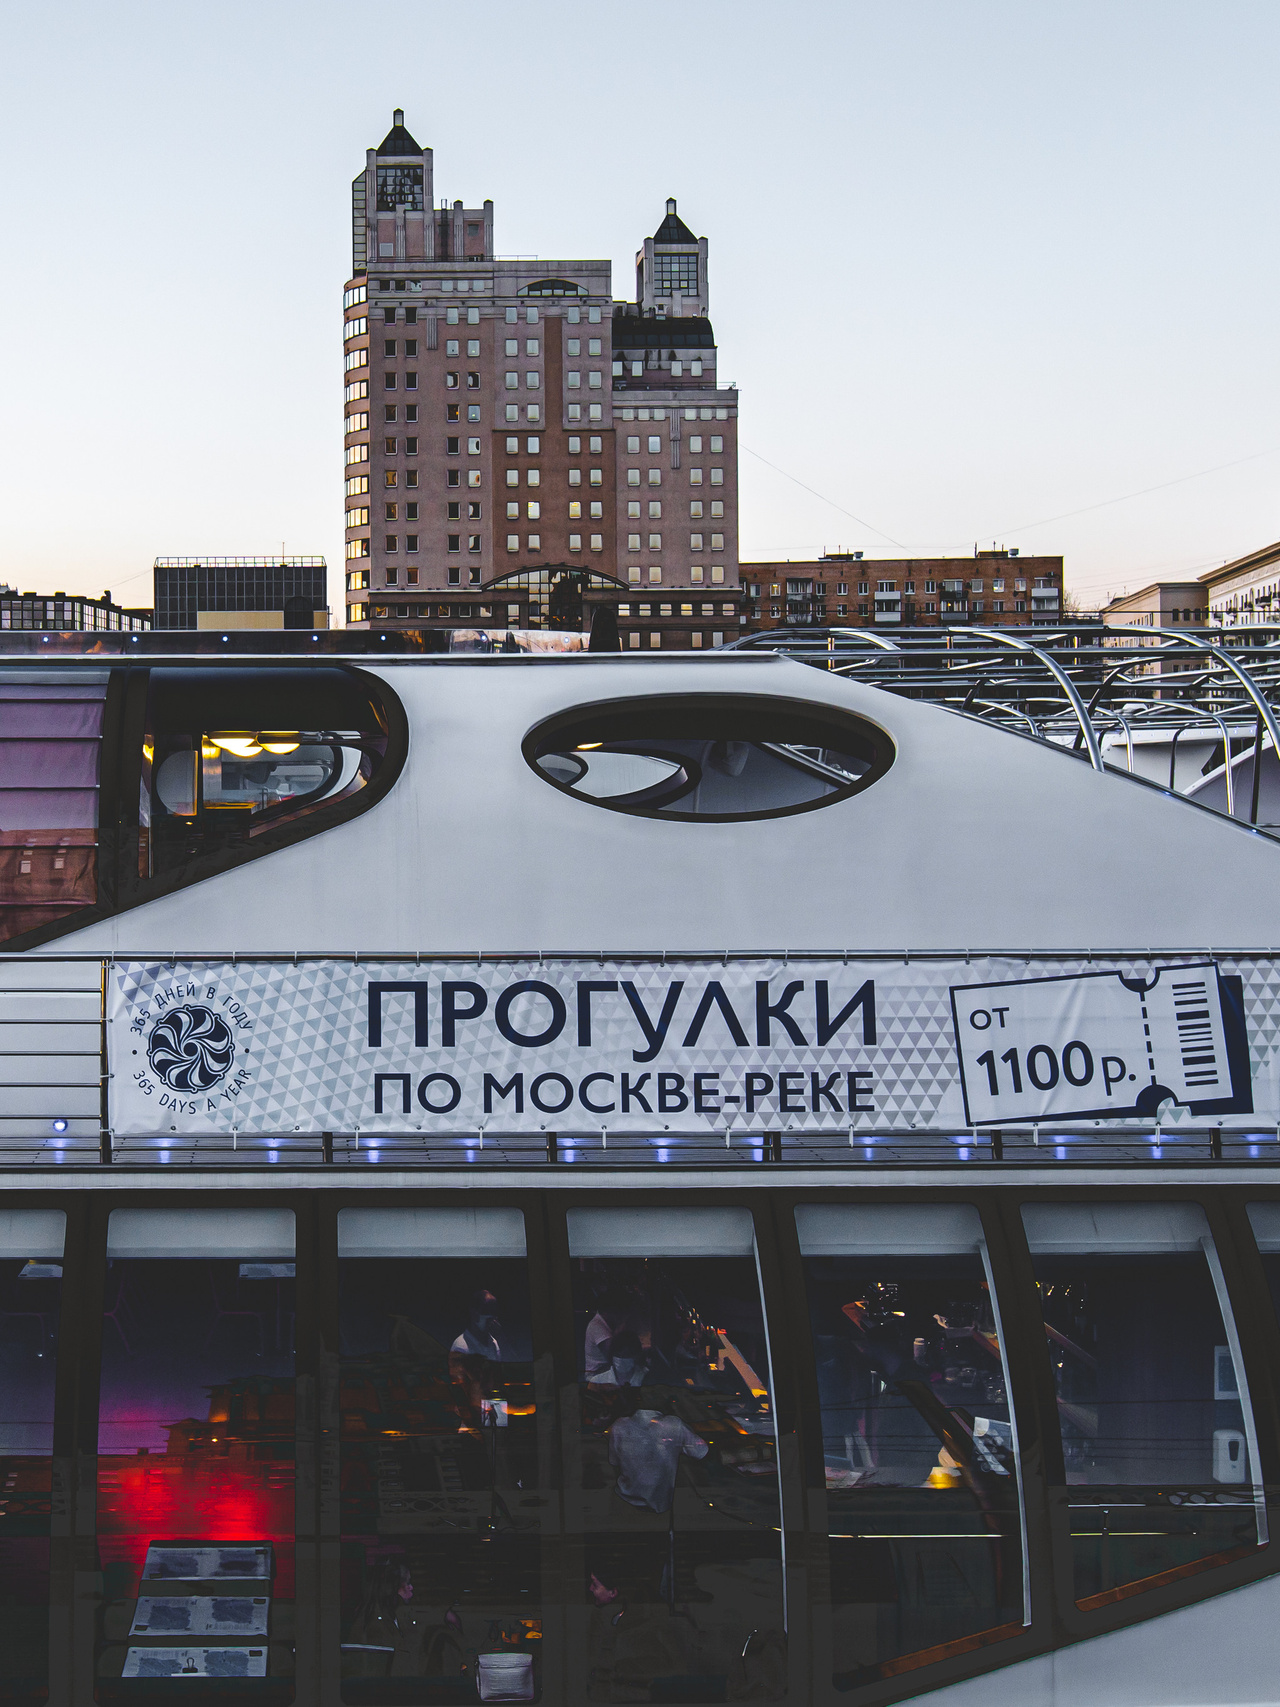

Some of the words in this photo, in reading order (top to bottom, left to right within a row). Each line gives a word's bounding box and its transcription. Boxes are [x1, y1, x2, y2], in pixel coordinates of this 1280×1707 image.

[130, 1008, 151, 1036] 365
[154, 981, 196, 1009] ДНЕЙ
[222, 995, 253, 1031] ГОДУ
[367, 979, 878, 1063] ПРОГУЛКИ
[133, 1070, 156, 1096] 365
[159, 1093, 197, 1115] DAYS
[207, 1098, 217, 1112] A
[220, 1069, 252, 1102] YEAR
[374, 1072, 462, 1114] ПО
[482, 1070, 876, 1114] МОСКВЕ-РЕКЕ
